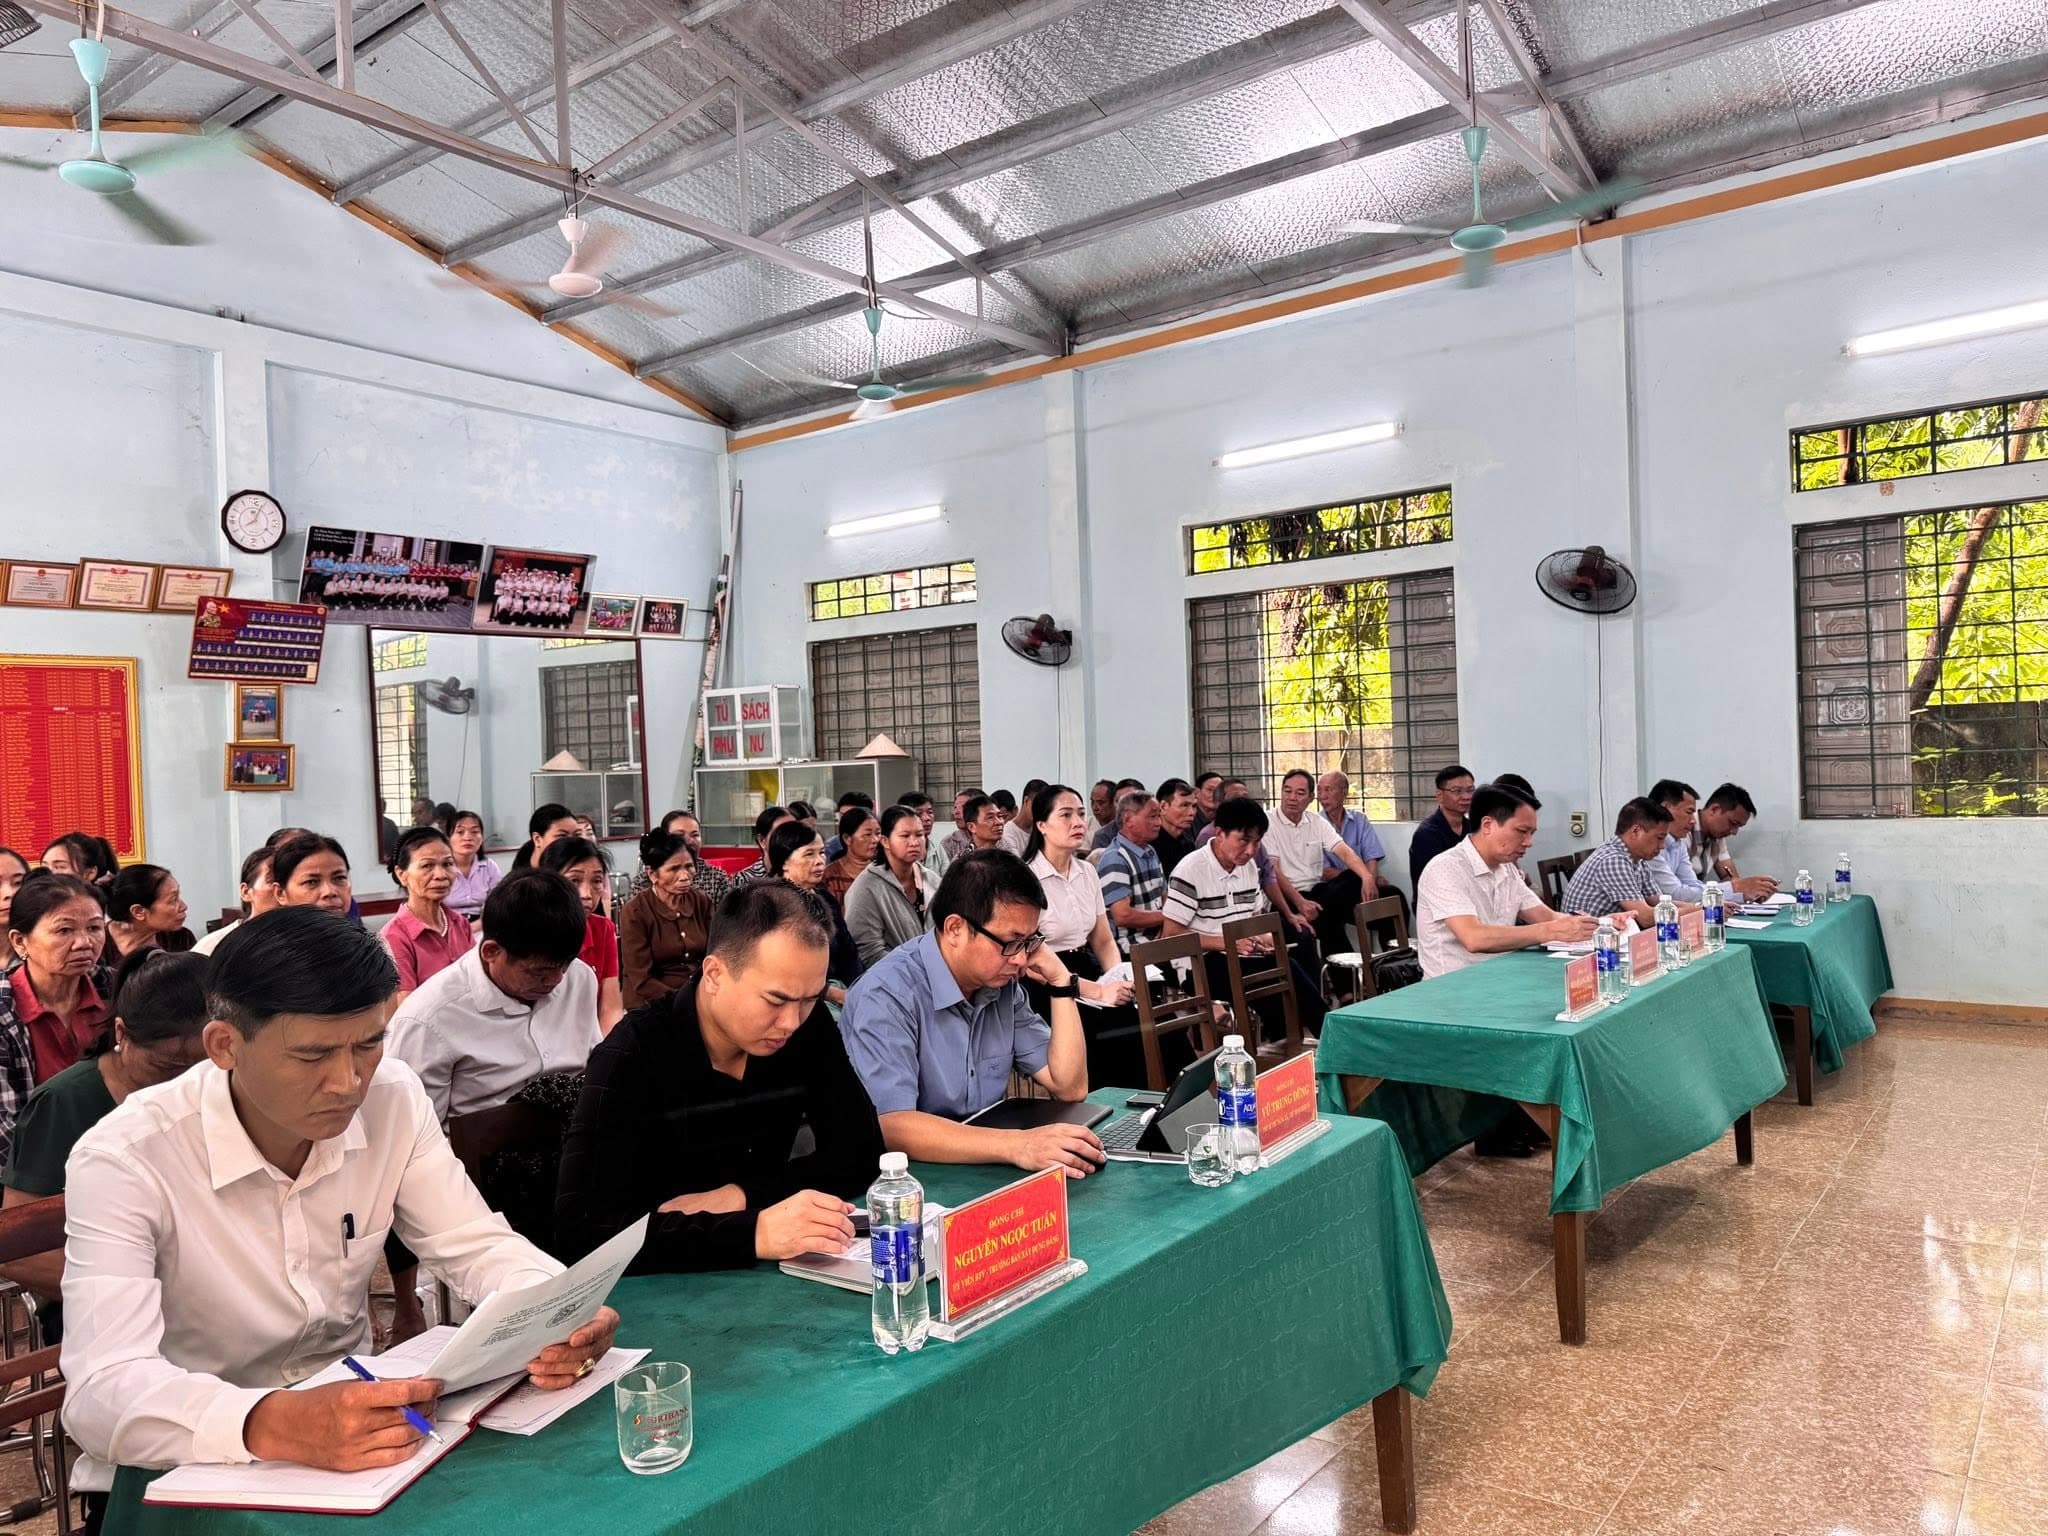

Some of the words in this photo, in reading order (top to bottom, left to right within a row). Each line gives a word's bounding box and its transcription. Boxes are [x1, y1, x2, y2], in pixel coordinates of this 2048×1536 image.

[741, 697, 770, 721] SÁCH
[989, 1212, 1010, 1229] ĐỒNG
[1011, 1206, 1024, 1220] CHÍ
[954, 1237, 998, 1270] NGUYỄN
[1000, 1223, 1029, 1247] NGỌC
[1031, 1209, 1057, 1234] TUẤN
